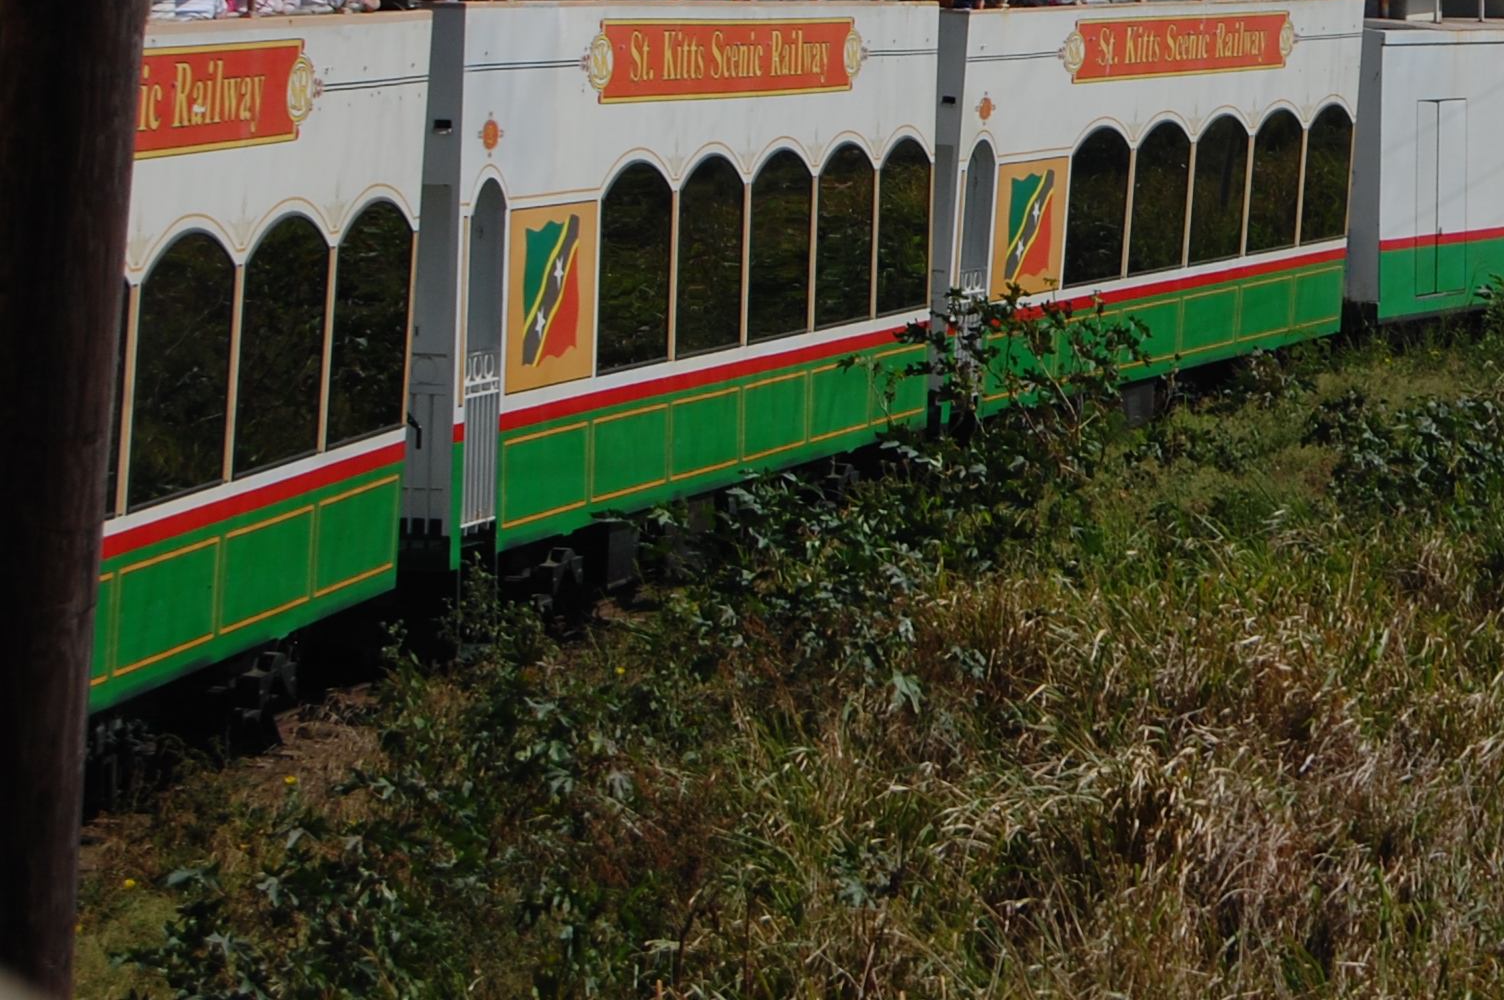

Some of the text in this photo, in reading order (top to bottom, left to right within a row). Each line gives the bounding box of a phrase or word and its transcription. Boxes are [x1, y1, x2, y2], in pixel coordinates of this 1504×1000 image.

[630, 29, 831, 84] St. Kitts Scenic Railway
[1098, 22, 1268, 67] St. Kitts Scenic Railway
[171, 59, 267, 134] Railway
